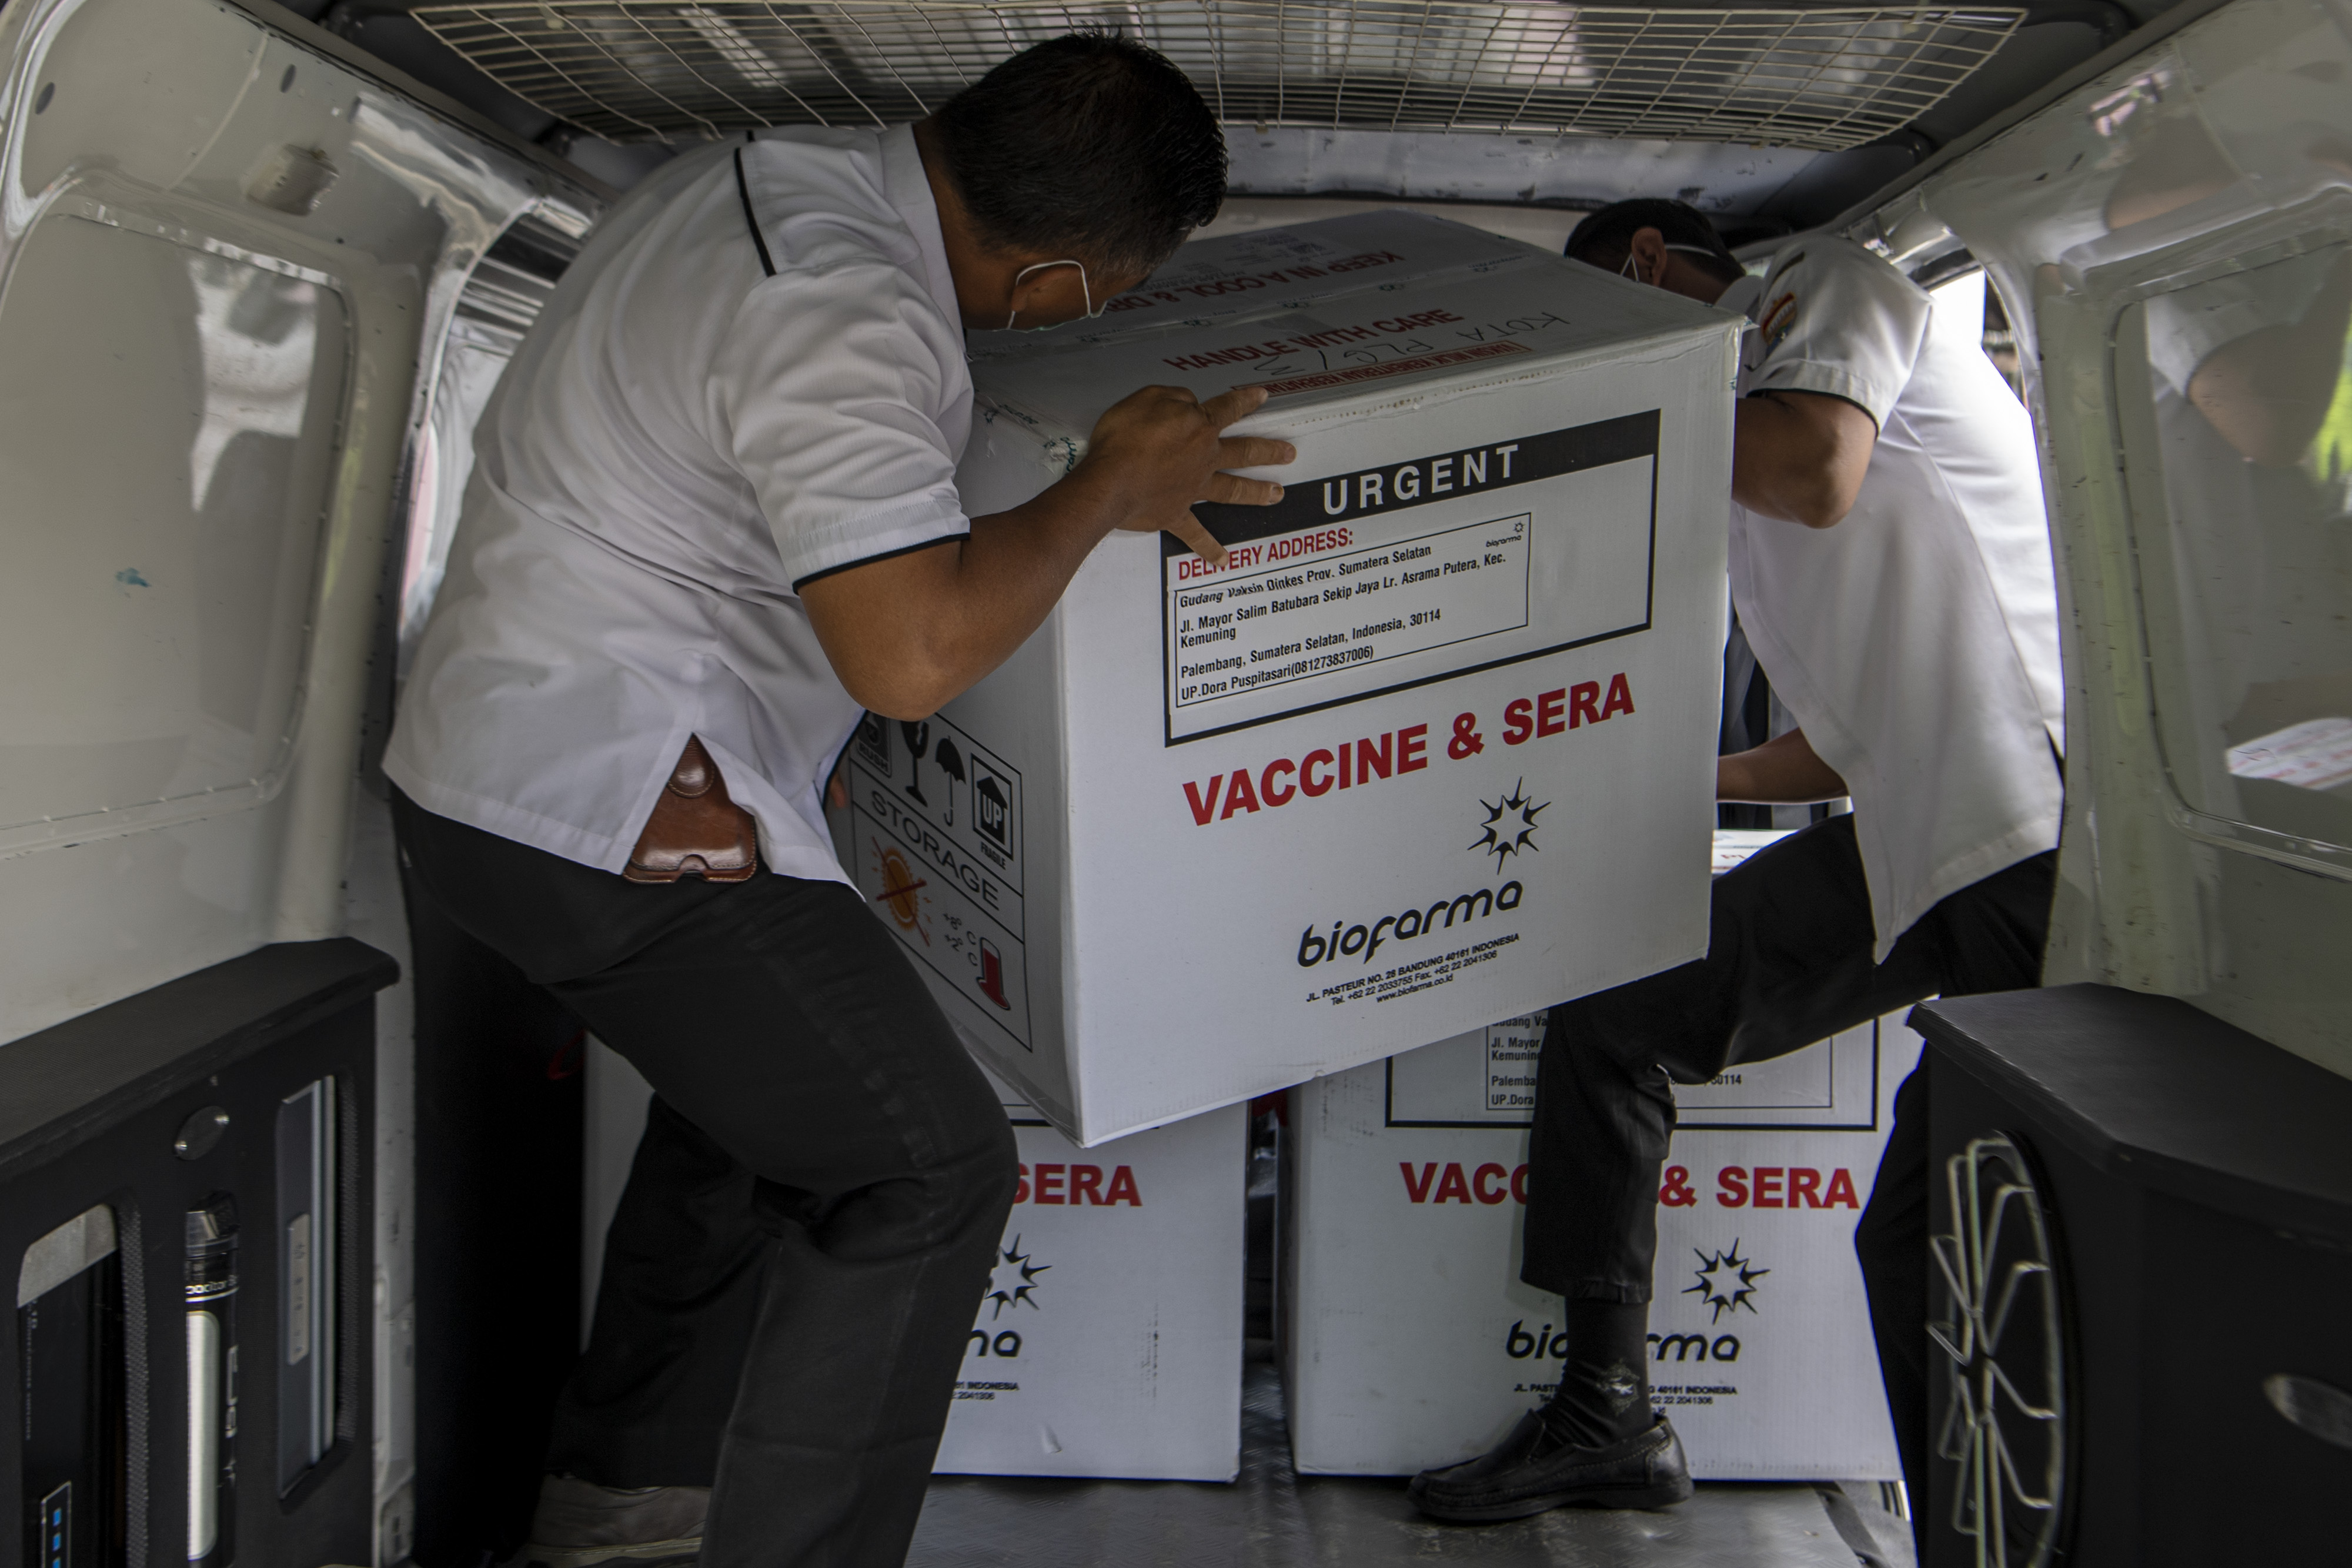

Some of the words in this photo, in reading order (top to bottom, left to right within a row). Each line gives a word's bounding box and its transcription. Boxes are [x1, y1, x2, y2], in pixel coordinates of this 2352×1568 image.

[1284, 265, 1328, 279] IN
[1328, 251, 1405, 272] KEEP
[1175, 278, 1266, 297] COOL
[1259, 271, 1291, 282] A
[1154, 291, 1180, 302] &
[1456, 312, 1570, 341] KOTA
[1163, 340, 1300, 371] HANDLE
[1288, 326, 1380, 349] WITH
[1372, 309, 1465, 333] CARE
[1471, 343, 1520, 359] VAKSIN
[1342, 357, 1434, 382] KEMENTERIAN
[1432, 350, 1471, 366] MILIK
[1265, 374, 1341, 393] KESEHATAN
[1324, 444, 1520, 515] URGENT
[1267, 527, 1353, 562] ADDRESS:
[1180, 591, 1223, 608] Gudang
[1228, 583, 1264, 598] Vaksin
[1267, 574, 1304, 591] Dinkes
[1307, 568, 1335, 583] Prov.
[1339, 554, 1389, 576] Sumatera
[1392, 546, 1432, 563] Selatan
[1199, 613, 1232, 630] Mayor
[1236, 605, 1267, 621] Salim
[1271, 594, 1319, 613] Batubara
[1323, 586, 1352, 602] Sekip
[1355, 580, 1379, 595] Jaya
[1384, 577, 1398, 589] Lr.
[1402, 568, 1440, 585] Asrama
[1444, 559, 1480, 575] Putera,
[1484, 553, 1506, 566] Kec.
[1181, 627, 1236, 648] Kemuning
[1181, 656, 1246, 678] Palembang,
[1250, 642, 1301, 663] Sumatera
[1305, 633, 1348, 650] Selatan,
[1352, 618, 1406, 640] Indonesia,
[1409, 608, 1441, 626] 30114
[1181, 681, 1227, 700] UP.Dora
[1182, 723, 1429, 827] VACCINE
[1447, 712, 1485, 760] &
[1502, 673, 1636, 745] SERA
[982, 792, 1003, 830] UP
[871, 790, 999, 911] STORAGE
[980, 840, 1006, 870] FRAGILE
[1297, 880, 1524, 968] biofarma
[1322, 978, 1366, 998] PASTEUR
[1367, 974, 1384, 985] NO.
[1386, 969, 1396, 979] 28
[1398, 955, 1444, 976] BANDUNG
[1445, 947, 1469, 961] 40161
[1472, 932, 1519, 953] INDONESIA
[1331, 995, 1345, 1005] Tel.
[1348, 989, 1364, 999] +62
[1365, 986, 1377, 996] 22
[1378, 975, 1413, 992] 2033755
[1434, 964, 1449, 974] +62
[1451, 961, 1462, 971] 22
[1463, 950, 1498, 967] 2041306
[1508, 1037, 1540, 1049] Mayor
[1491, 1075, 1536, 1086] Palemba
[1491, 1094, 1534, 1105] UP.Dora
[1659, 1166, 1697, 1207] &
[1718, 1166, 1861, 1209] SERA
[967, 1382, 1020, 1390] INDONESIA
[1685, 1386, 1738, 1394] INDONESIA
